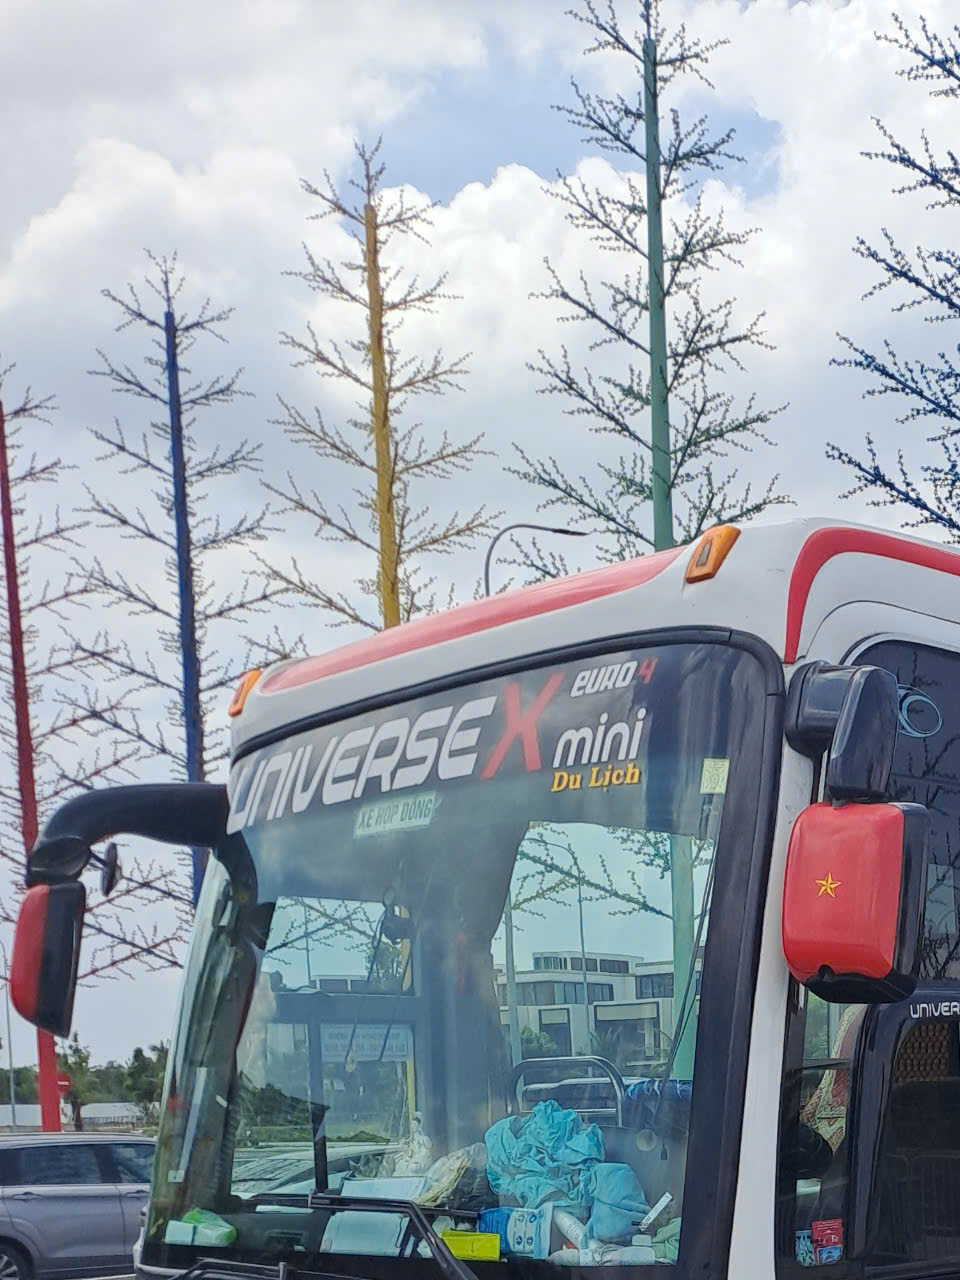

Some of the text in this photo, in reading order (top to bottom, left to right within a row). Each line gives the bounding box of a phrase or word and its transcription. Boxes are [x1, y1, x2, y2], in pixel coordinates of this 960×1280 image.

[637, 655, 658, 684] 4
[226, 671, 565, 836] UNIVERSE X
[552, 707, 647, 769] mini
[551, 762, 641, 792] Du Lịch
